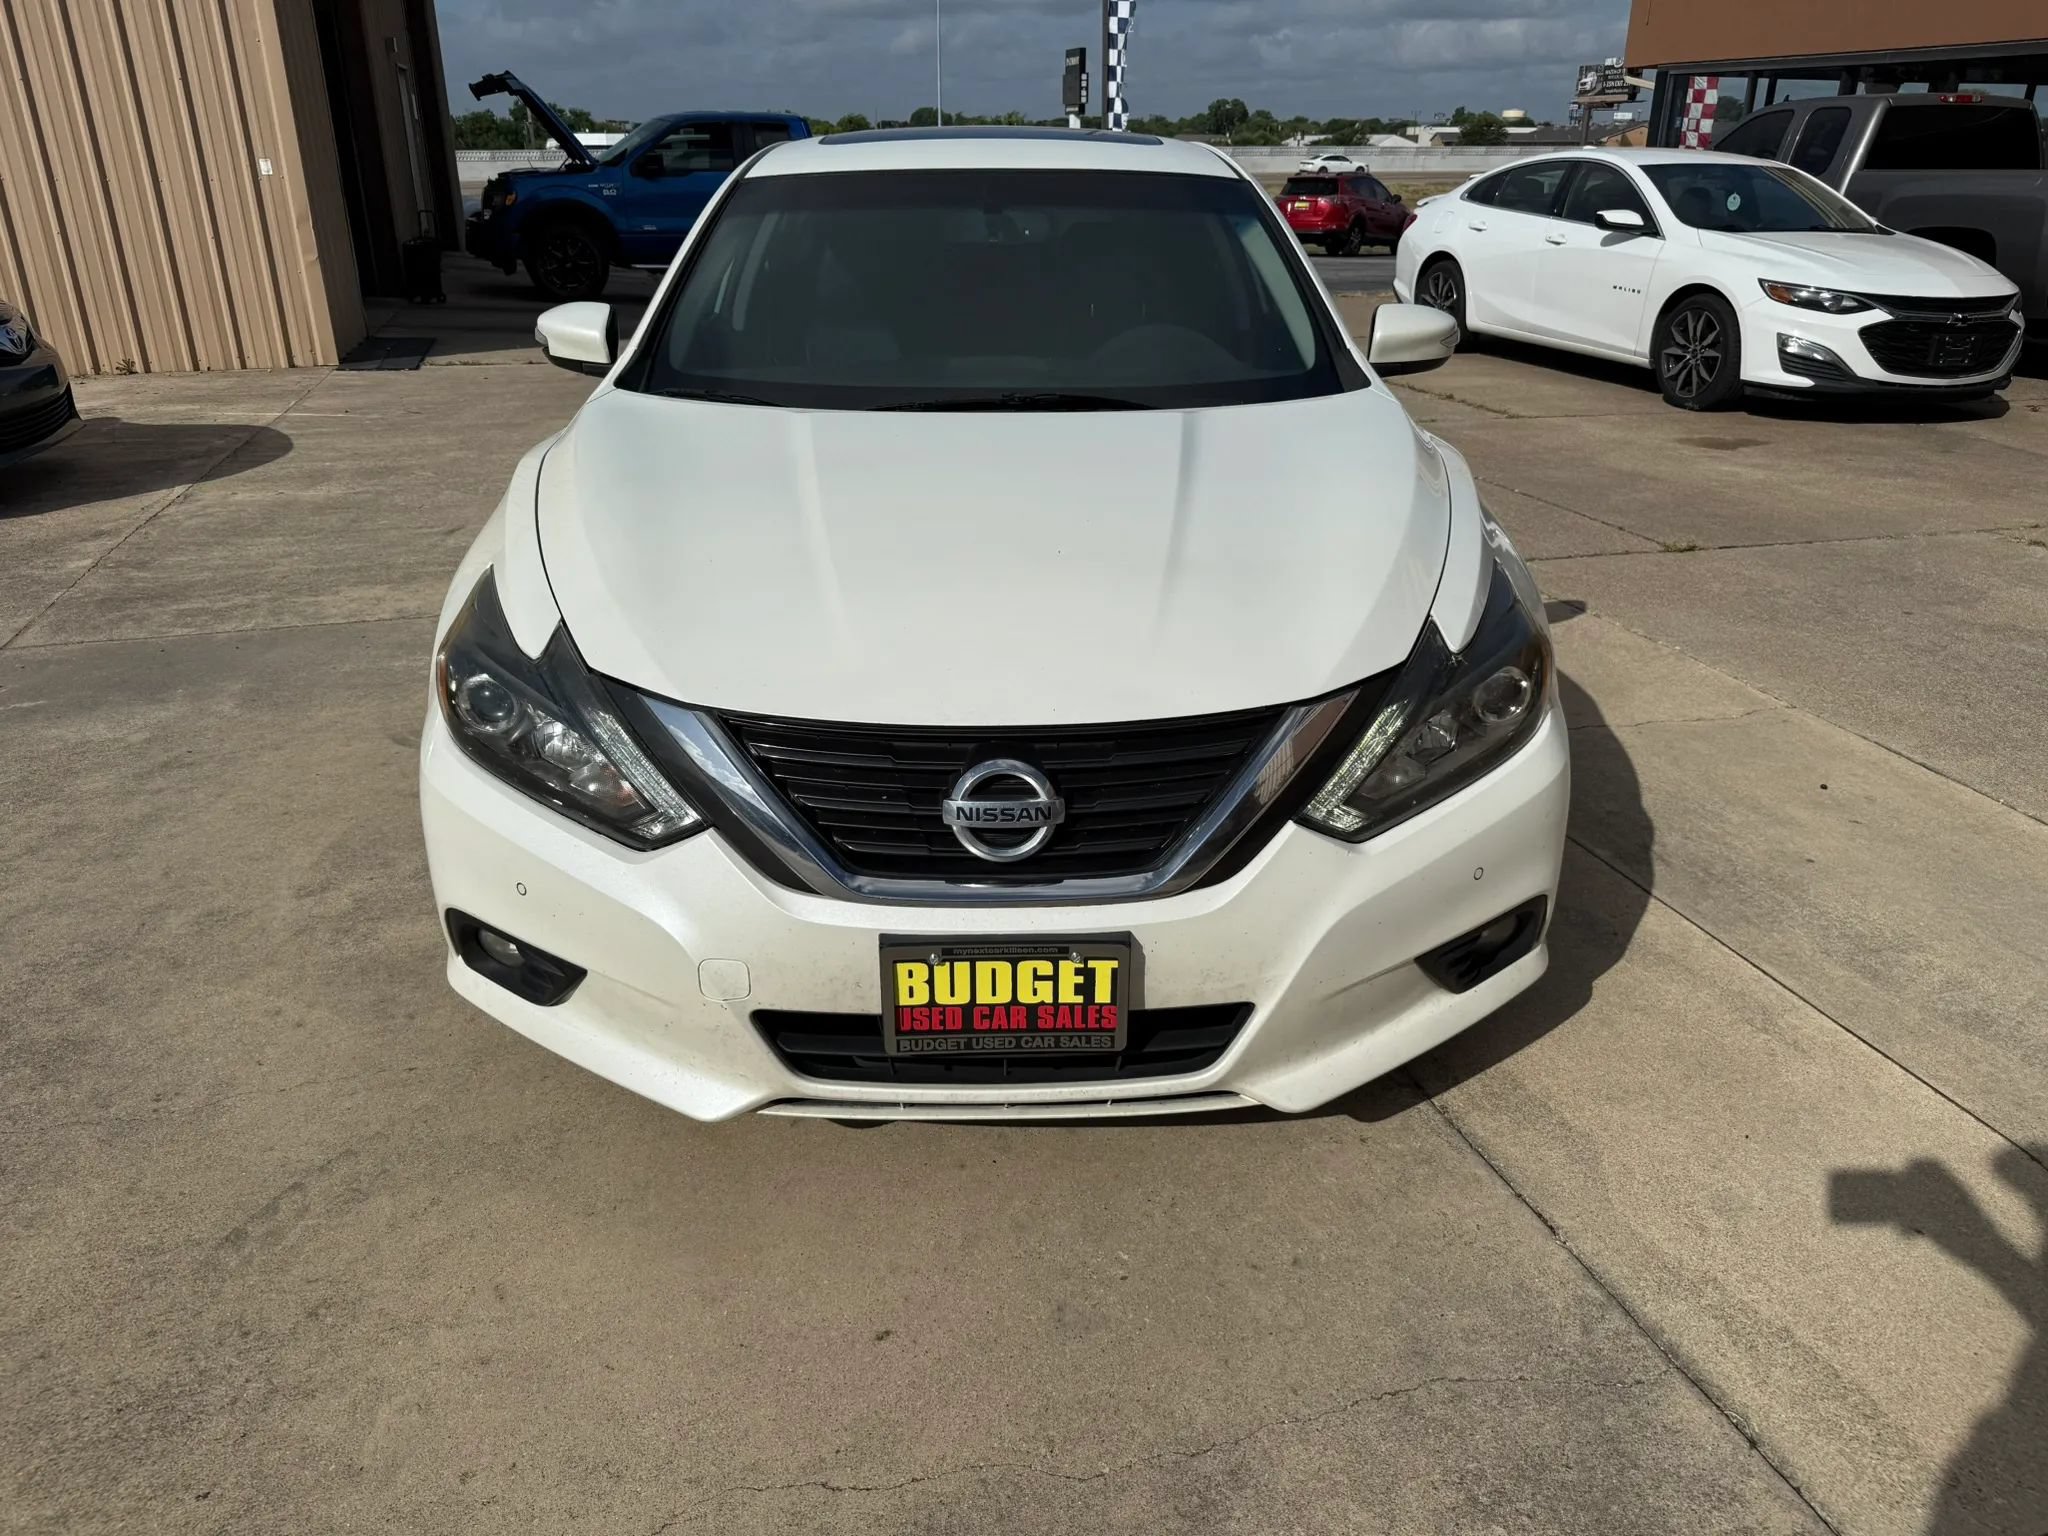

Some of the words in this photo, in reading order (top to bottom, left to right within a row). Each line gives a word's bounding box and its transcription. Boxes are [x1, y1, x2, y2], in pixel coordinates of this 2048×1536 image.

[956, 806, 1052, 822] NISSAN
[895, 960, 1119, 1006] BUDGET
[898, 1006, 963, 1032] USED
[973, 1005, 1027, 1030] CAR
[1037, 1005, 1118, 1030] SALES
[900, 1037, 968, 1051] BUDGET
[971, 1036, 1016, 1050] USED
[1021, 1036, 1055, 1049] CAR
[1059, 1035, 1112, 1048] SALES
